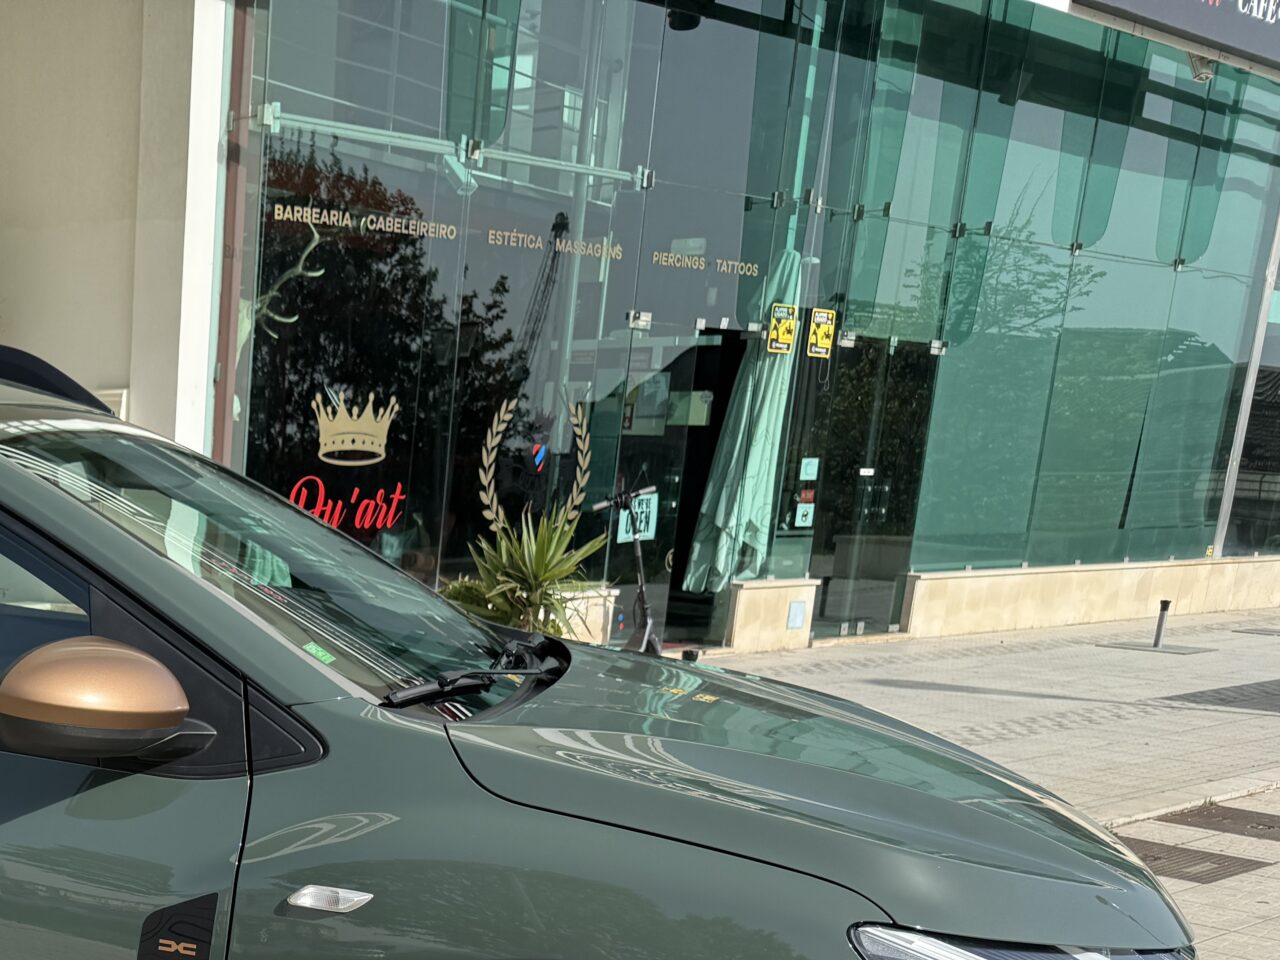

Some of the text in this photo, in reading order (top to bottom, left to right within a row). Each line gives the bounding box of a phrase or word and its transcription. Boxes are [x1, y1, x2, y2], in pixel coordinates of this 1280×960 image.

[274, 204, 457, 240] BARBEARIA CABELEIREIRO
[488, 228, 544, 250] ESTÉTICA
[652, 251, 759, 277] PIERCINGS TATTOOS
